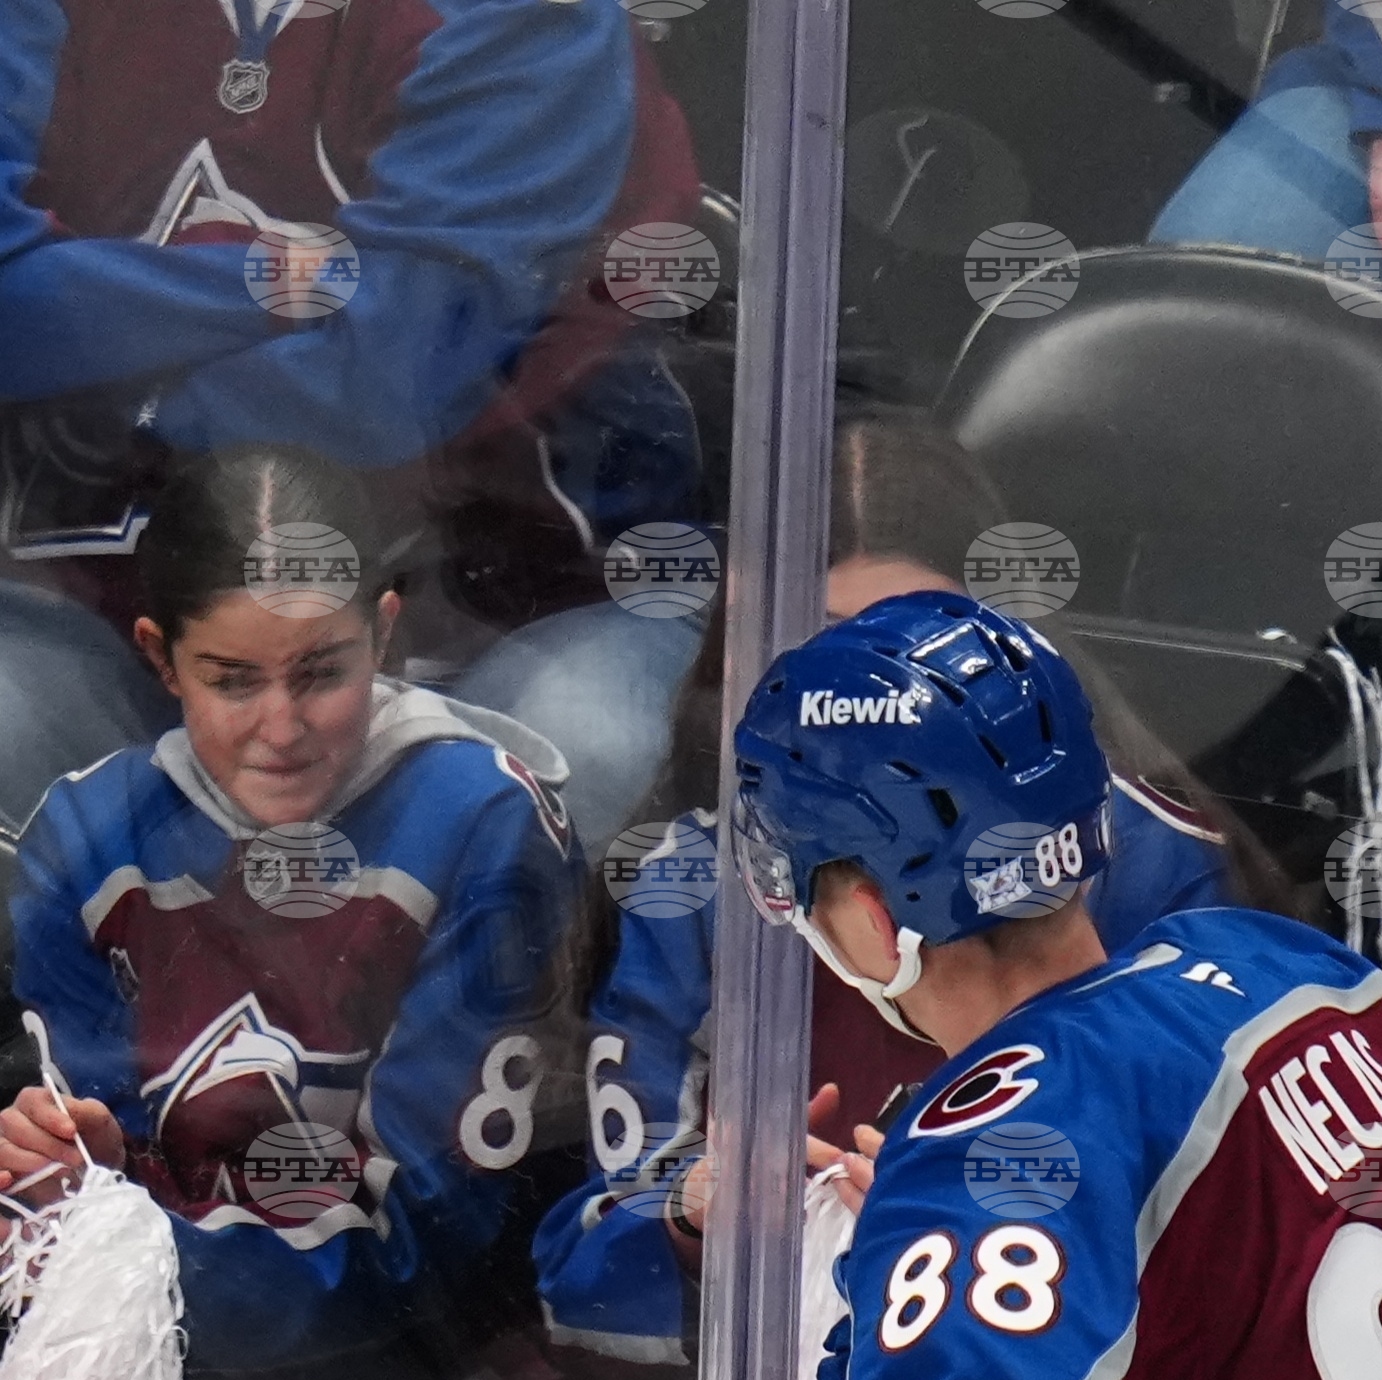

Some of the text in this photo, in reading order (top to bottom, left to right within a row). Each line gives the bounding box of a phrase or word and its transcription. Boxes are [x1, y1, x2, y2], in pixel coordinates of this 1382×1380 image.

[800, 689, 922, 726] Kiewit
[1035, 822, 1082, 887] 88
[460, 1035, 543, 1170] 8
[586, 1035, 644, 1172] 6
[878, 1223, 1066, 1353] 88
